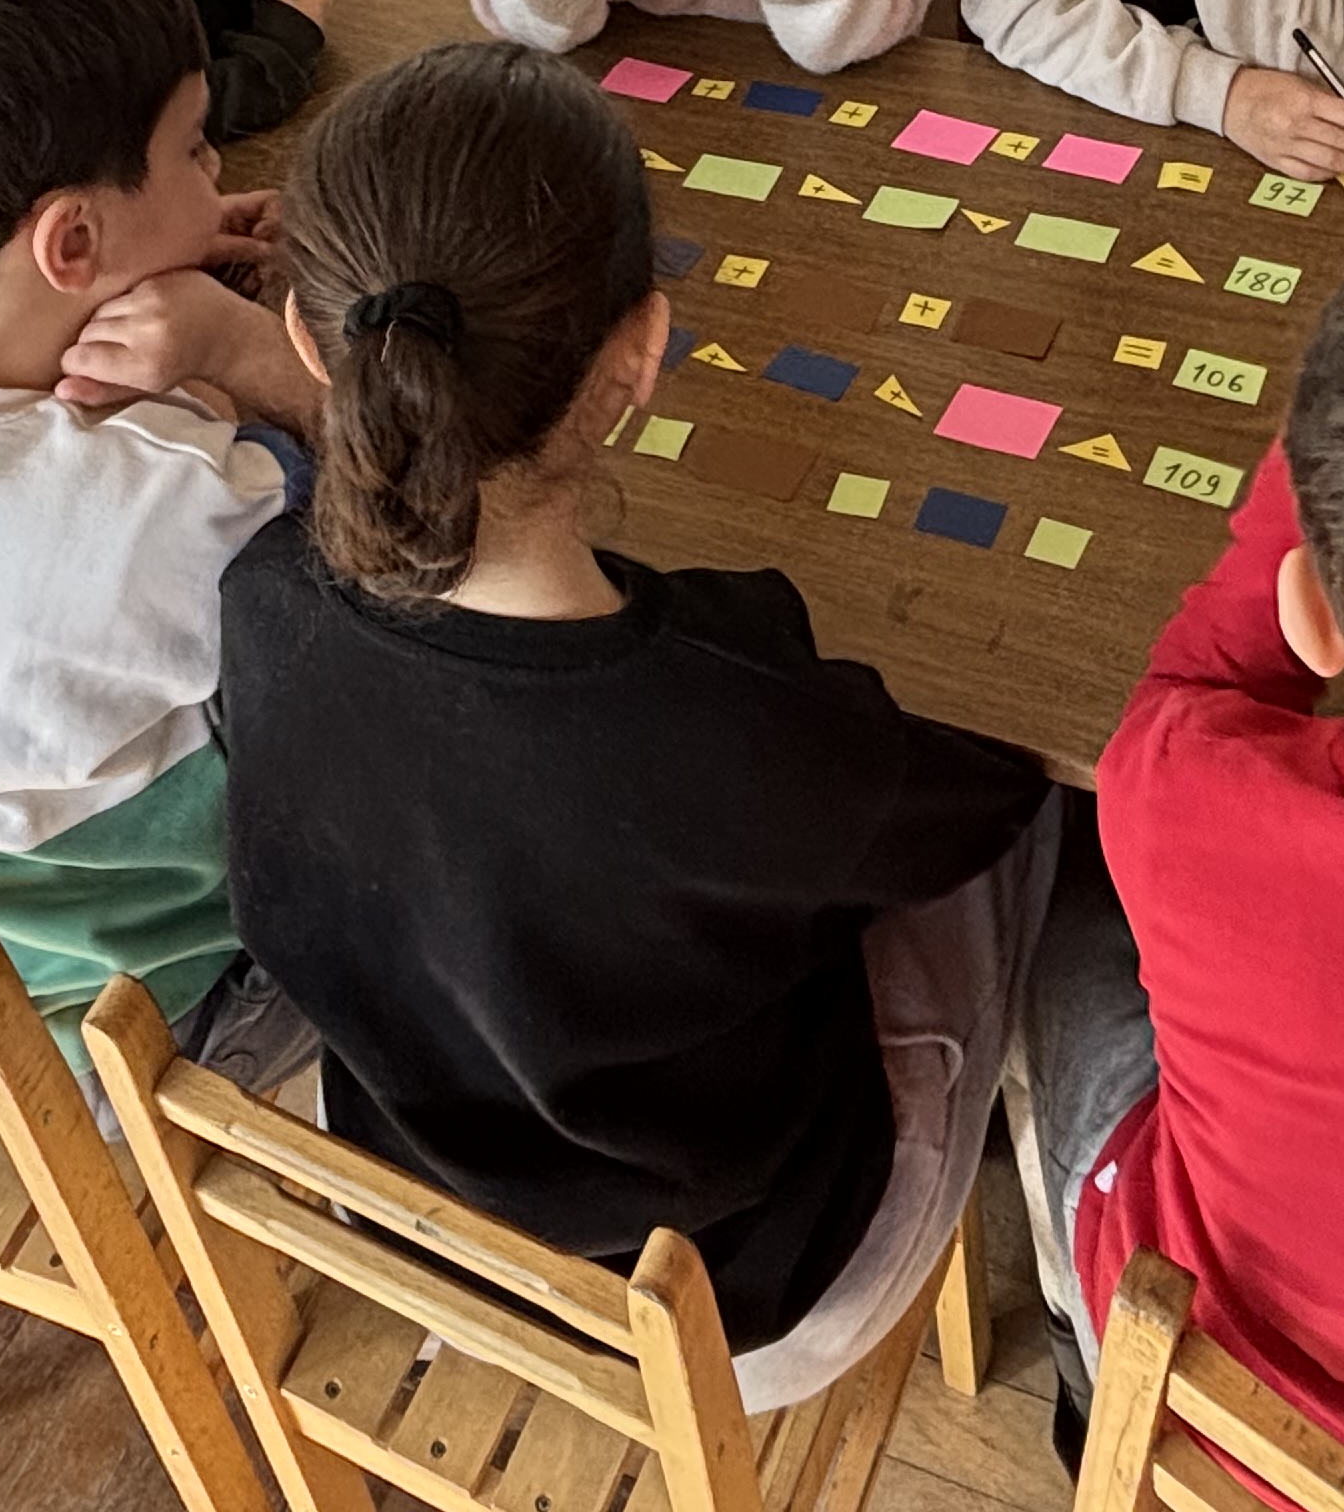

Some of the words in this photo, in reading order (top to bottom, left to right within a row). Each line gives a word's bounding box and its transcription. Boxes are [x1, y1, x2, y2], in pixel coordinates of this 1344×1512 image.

[1263, 181, 1307, 205] 97
[1234, 267, 1292, 296] 180
[1193, 363, 1246, 393] 106
[1164, 462, 1220, 496] 109
